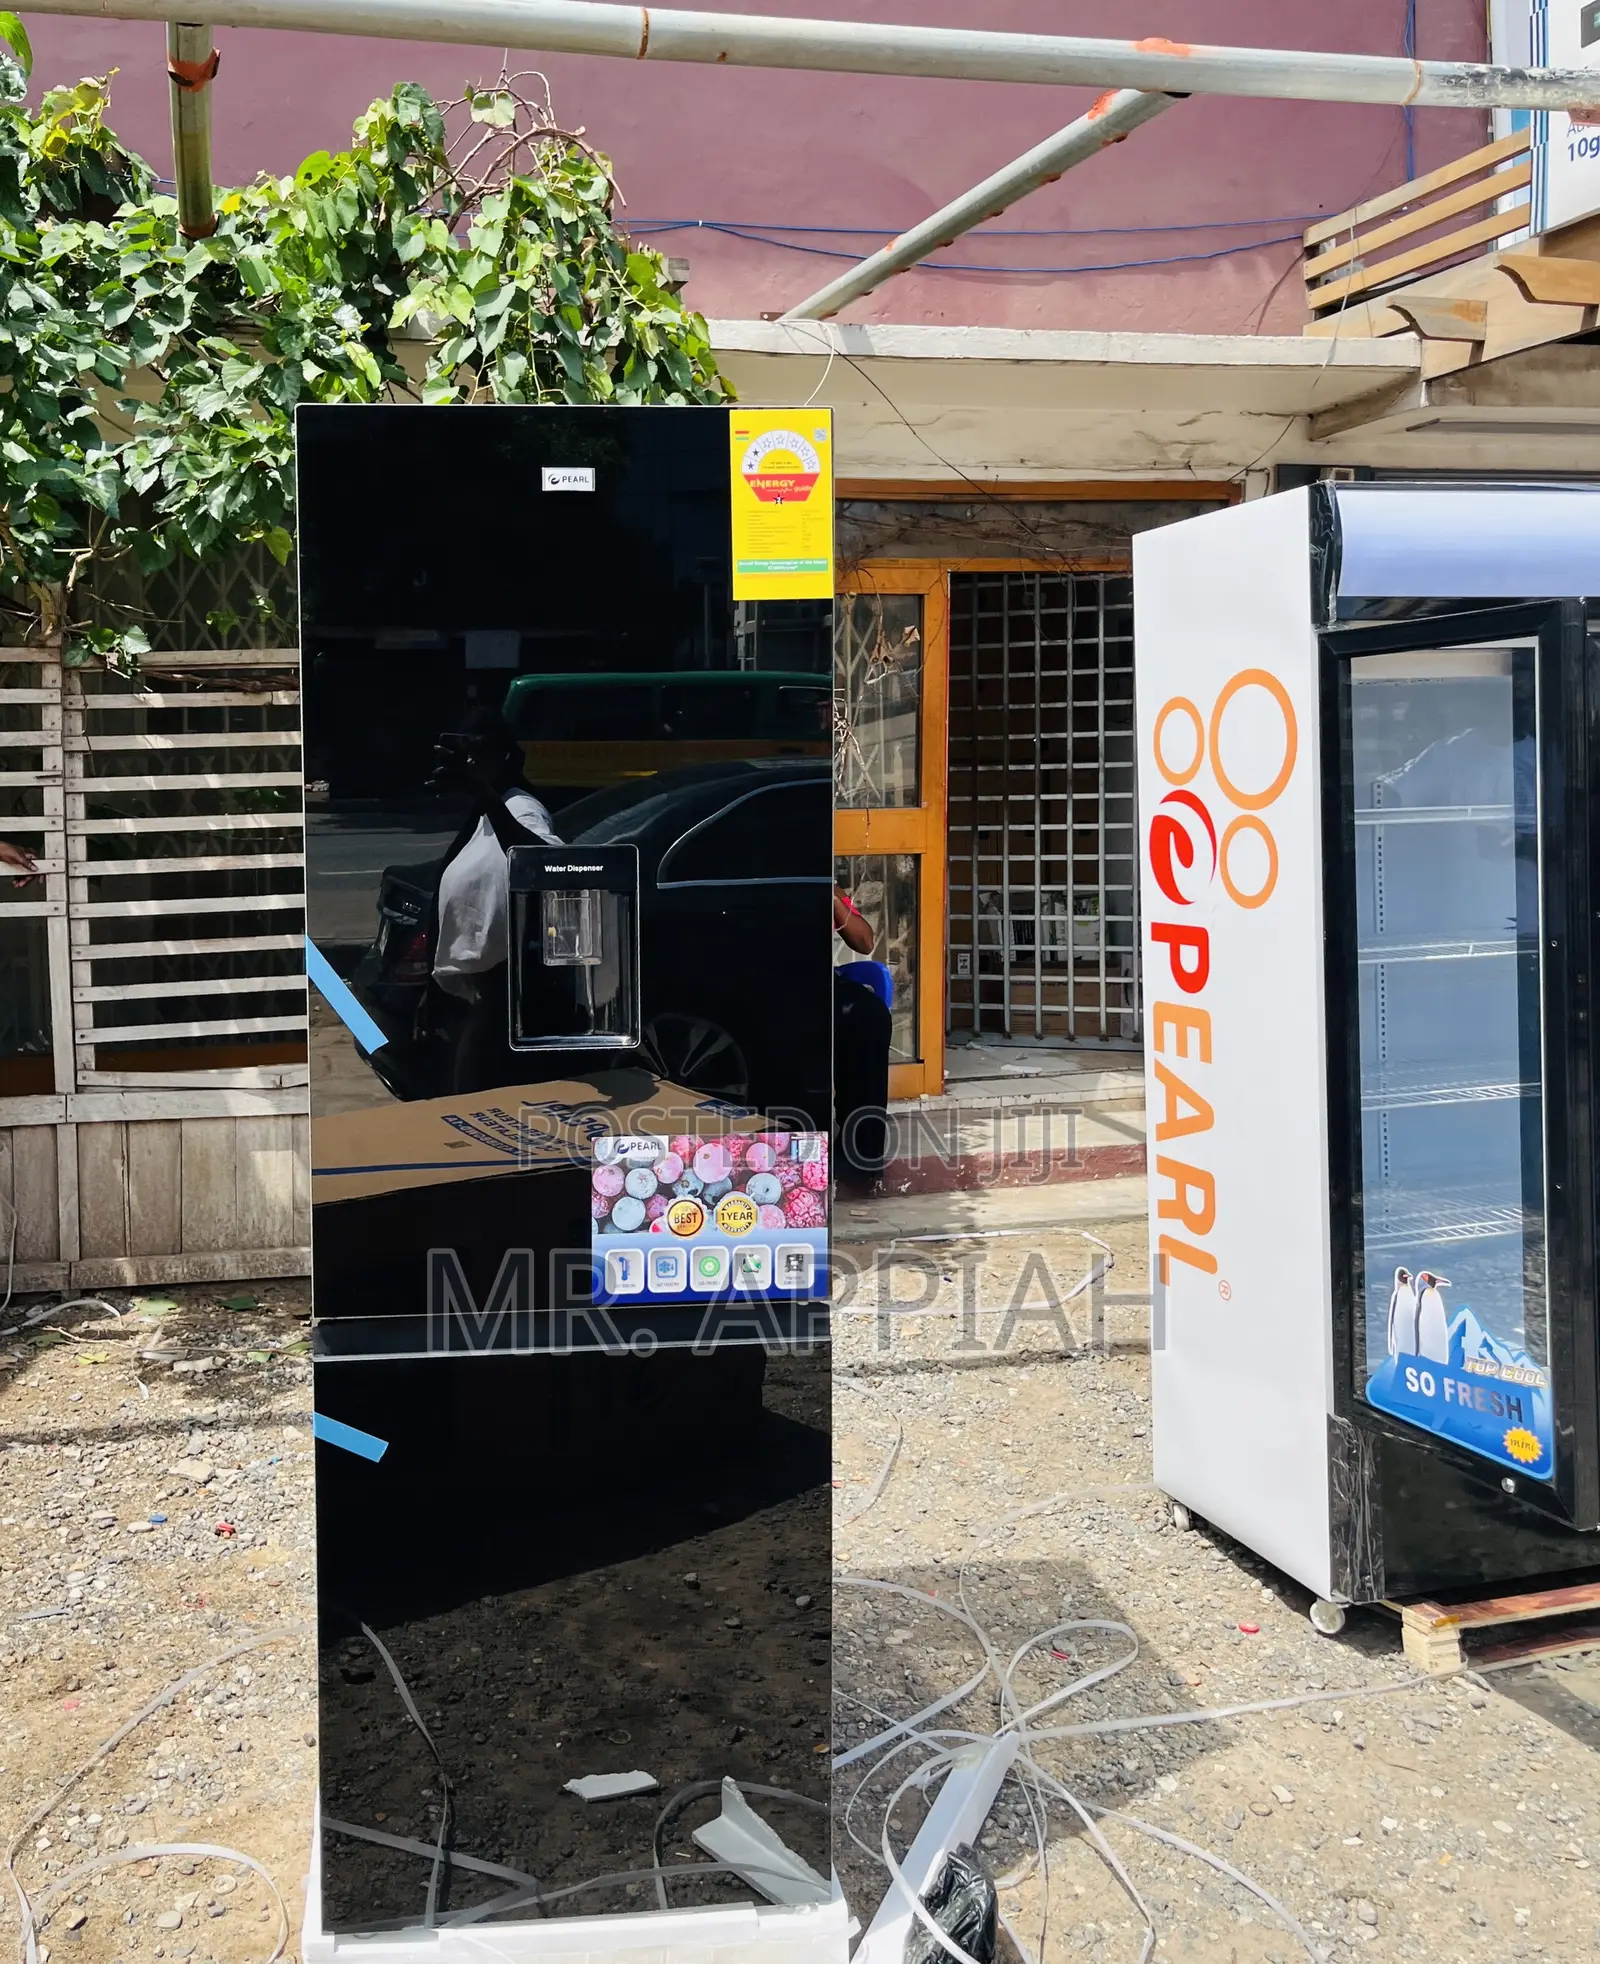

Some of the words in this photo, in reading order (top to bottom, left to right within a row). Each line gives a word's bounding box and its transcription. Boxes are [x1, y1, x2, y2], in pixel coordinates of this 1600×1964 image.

[562, 475, 590, 483] PEARL
[749, 479, 796, 489] ENERGY
[544, 865, 567, 873] Water
[567, 864, 604, 873] Dispenser
[1151, 921, 1218, 1287] PEARL
[630, 1141, 663, 1150] PEARL
[674, 1212, 698, 1224] BEST
[720, 1212, 725, 1221] 1
[726, 1211, 753, 1221] YEAR
[1465, 1356, 1499, 1377] TOP
[1500, 1364, 1548, 1388] COOL
[1405, 1366, 1436, 1398] SO
[1443, 1376, 1524, 1424] FRESH
